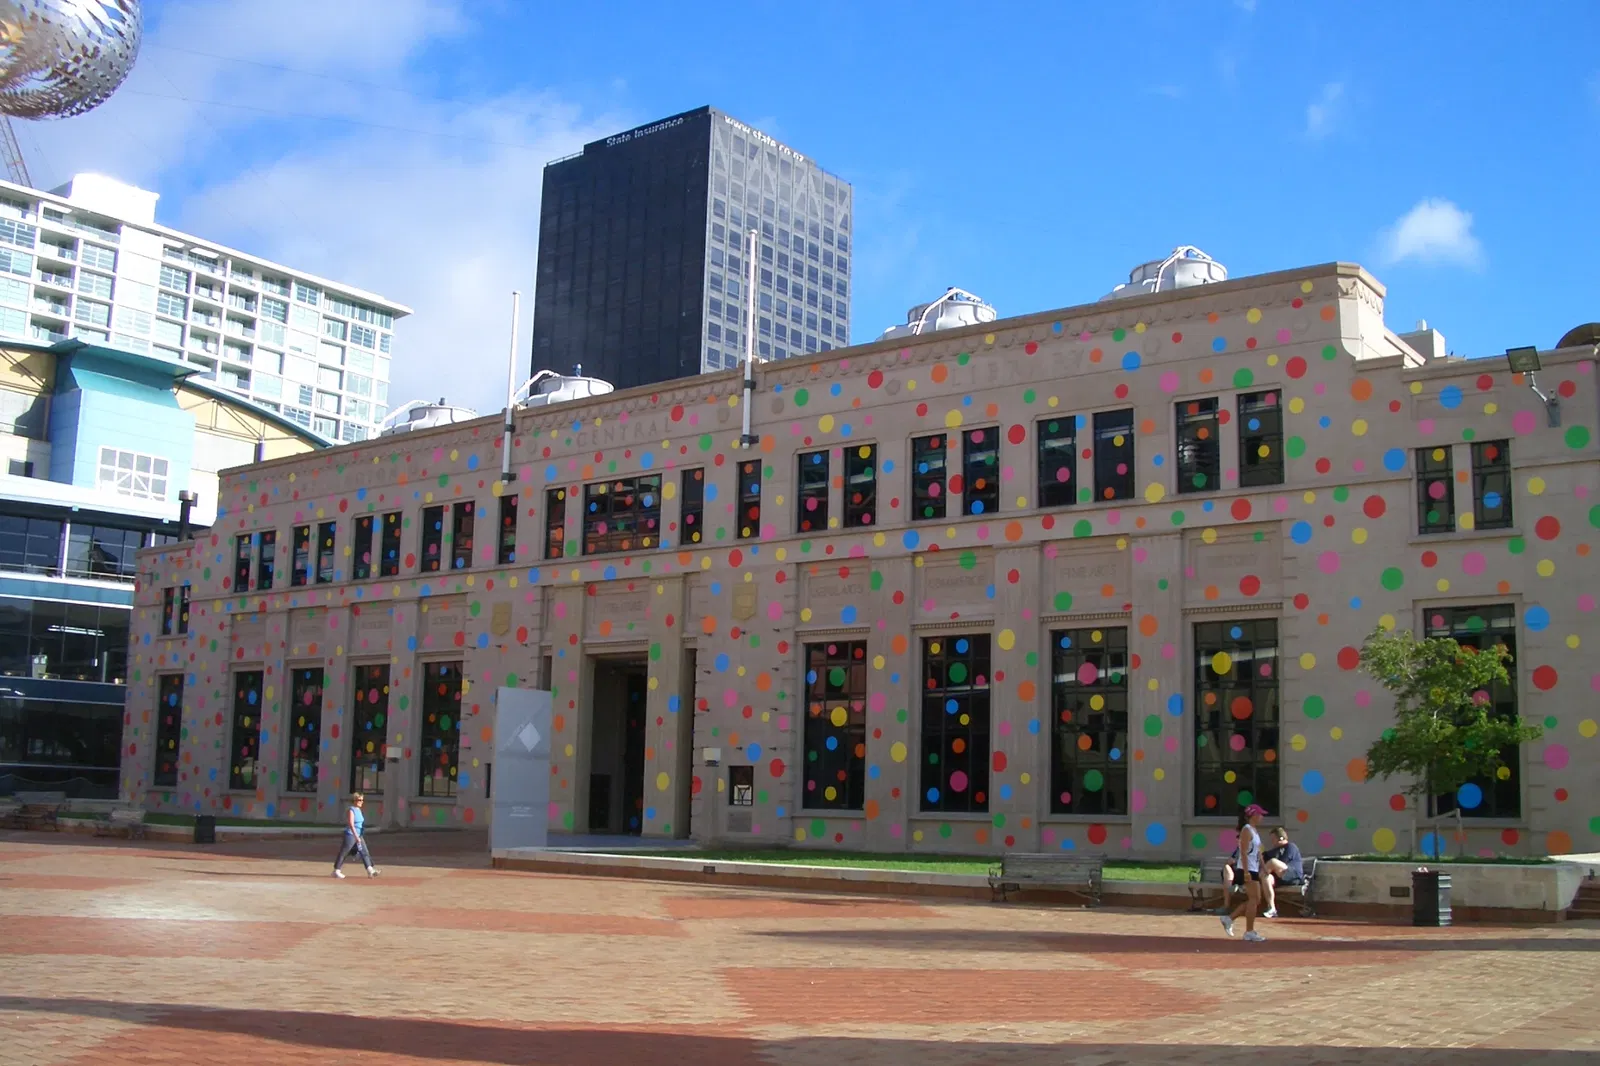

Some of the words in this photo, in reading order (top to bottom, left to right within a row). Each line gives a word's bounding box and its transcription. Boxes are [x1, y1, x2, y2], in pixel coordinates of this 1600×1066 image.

[606, 133, 632, 148] State
[634, 117, 684, 139] Insurance
[576, 416, 672, 448] CENTRAL
